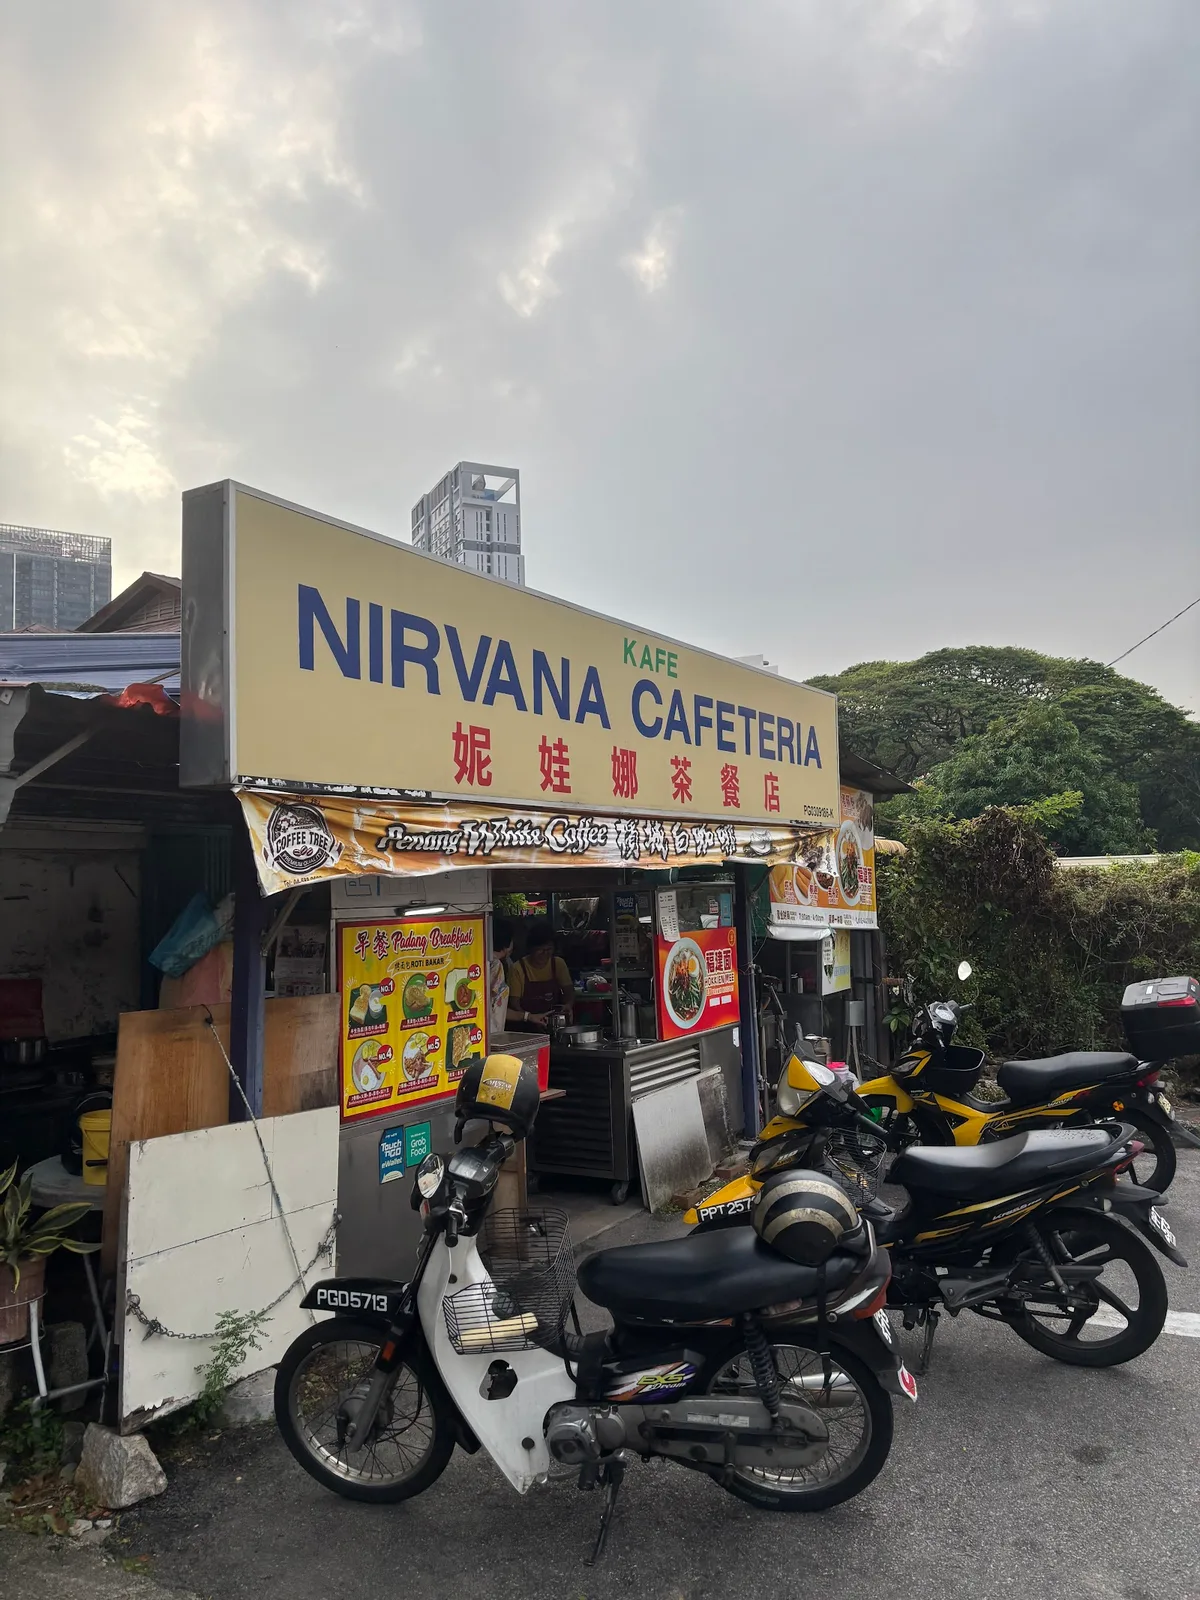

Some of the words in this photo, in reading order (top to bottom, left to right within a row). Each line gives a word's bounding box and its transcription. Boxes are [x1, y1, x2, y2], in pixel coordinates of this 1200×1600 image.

[623, 637, 678, 679] KAFE
[298, 583, 611, 731] NIRVANA
[631, 679, 822, 769] CAFETERIA
[452, 721, 781, 813] 妮娃娜茶餐店
[376, 825, 462, 855] Penang
[460, 816, 545, 855] White
[544, 815, 608, 854] Coffee
[275, 831, 307, 854] COFFEE
[309, 831, 329, 851] TREE
[355, 928, 389, 960] 早餐
[430, 925, 473, 950] Breakfast
[425, 957, 445, 967] BAKAR
[469, 967, 481, 979] NO.3
[380, 980, 394, 992] NO.1
[426, 974, 439, 987] NO.2
[470, 1031, 482, 1042] NO.6
[427, 1038, 440, 1050] NO.5
[378, 1048, 393, 1061] NO.4
[381, 1139, 402, 1152] Touch
[410, 1136, 427, 1148] Grab
[410, 1145, 427, 1157] Food
[700, 1204, 727, 1222] PPT
[727, 1195, 756, 1216] 257
[316, 1288, 388, 1312] PGD5713
[650, 1382, 687, 1390] Dream
